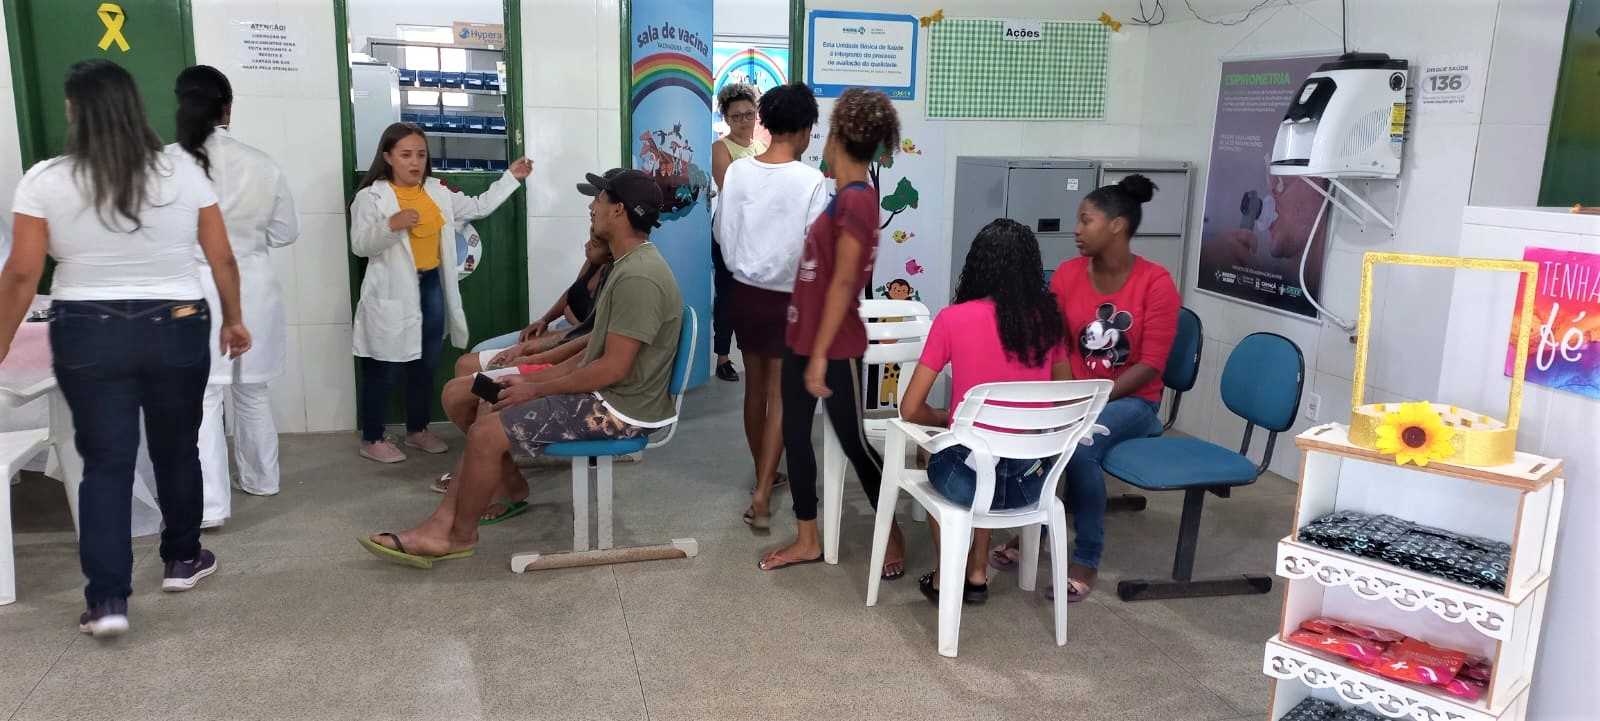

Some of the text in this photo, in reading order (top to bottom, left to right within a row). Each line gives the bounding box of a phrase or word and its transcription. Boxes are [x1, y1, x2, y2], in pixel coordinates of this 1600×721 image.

[637, 25, 659, 48] sala
[662, 22, 675, 39] de
[678, 27, 708, 56] vacina
[1006, 28, 1040, 38] Ações
[1429, 75, 1462, 91] 136
[1536, 302, 1587, 371] fé
